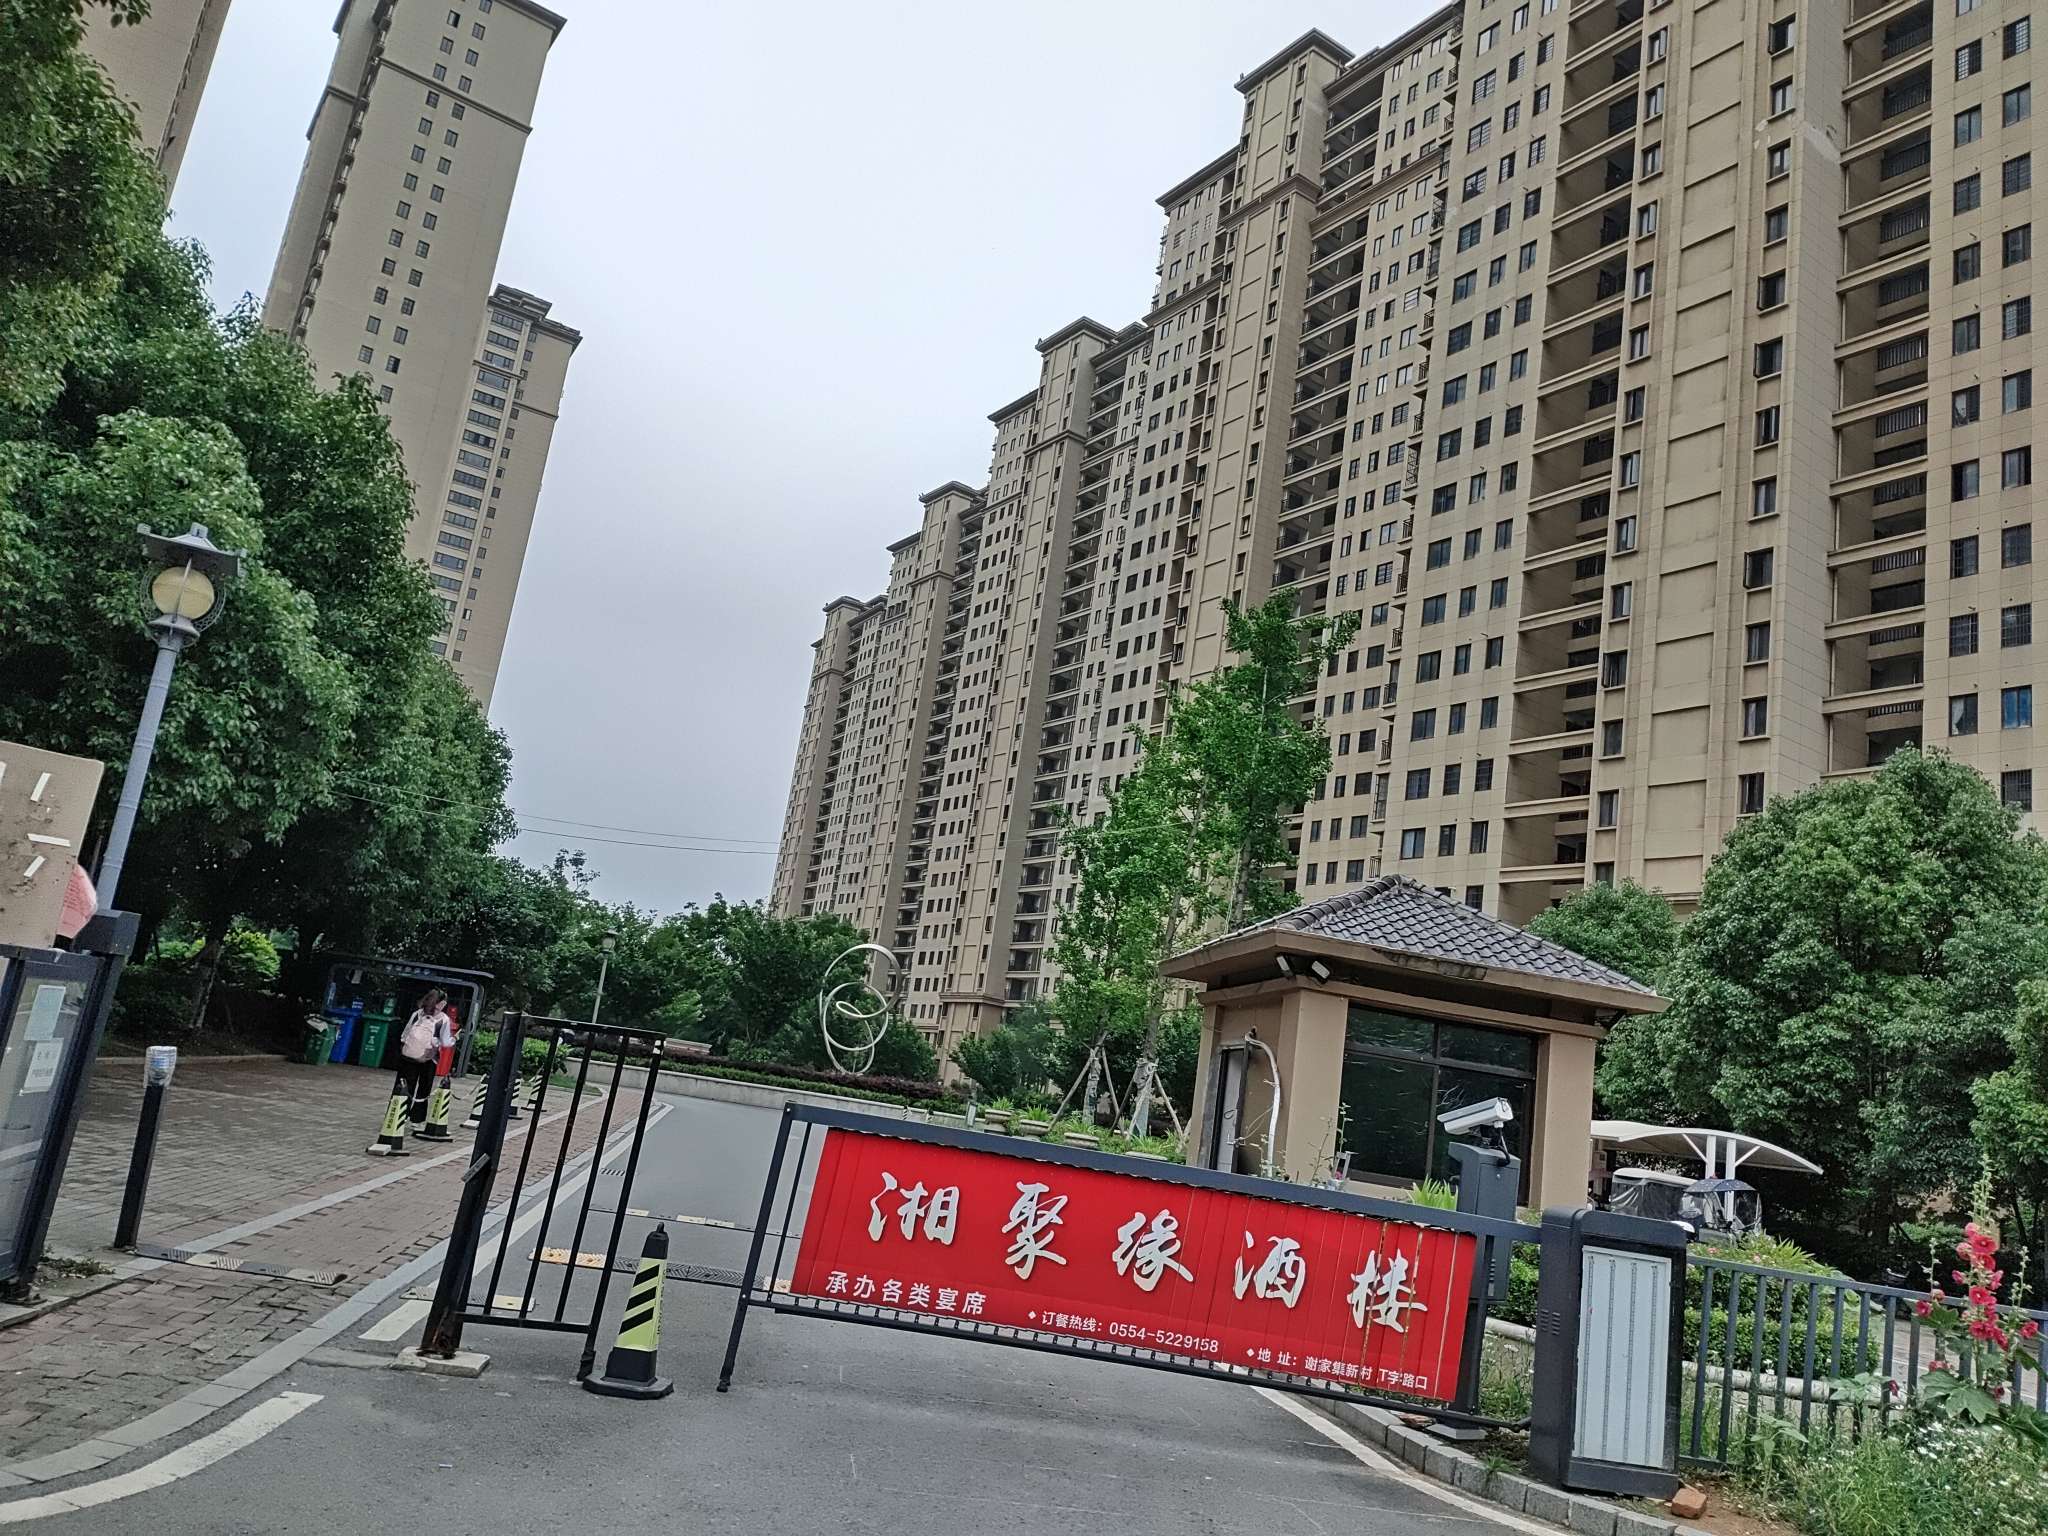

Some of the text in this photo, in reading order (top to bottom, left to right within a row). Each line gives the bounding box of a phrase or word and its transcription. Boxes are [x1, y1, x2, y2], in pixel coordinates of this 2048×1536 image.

[826, 1270, 987, 1316] 承办各类宴席
[868, 1171, 1428, 1333] 湘聚缘酒楼
